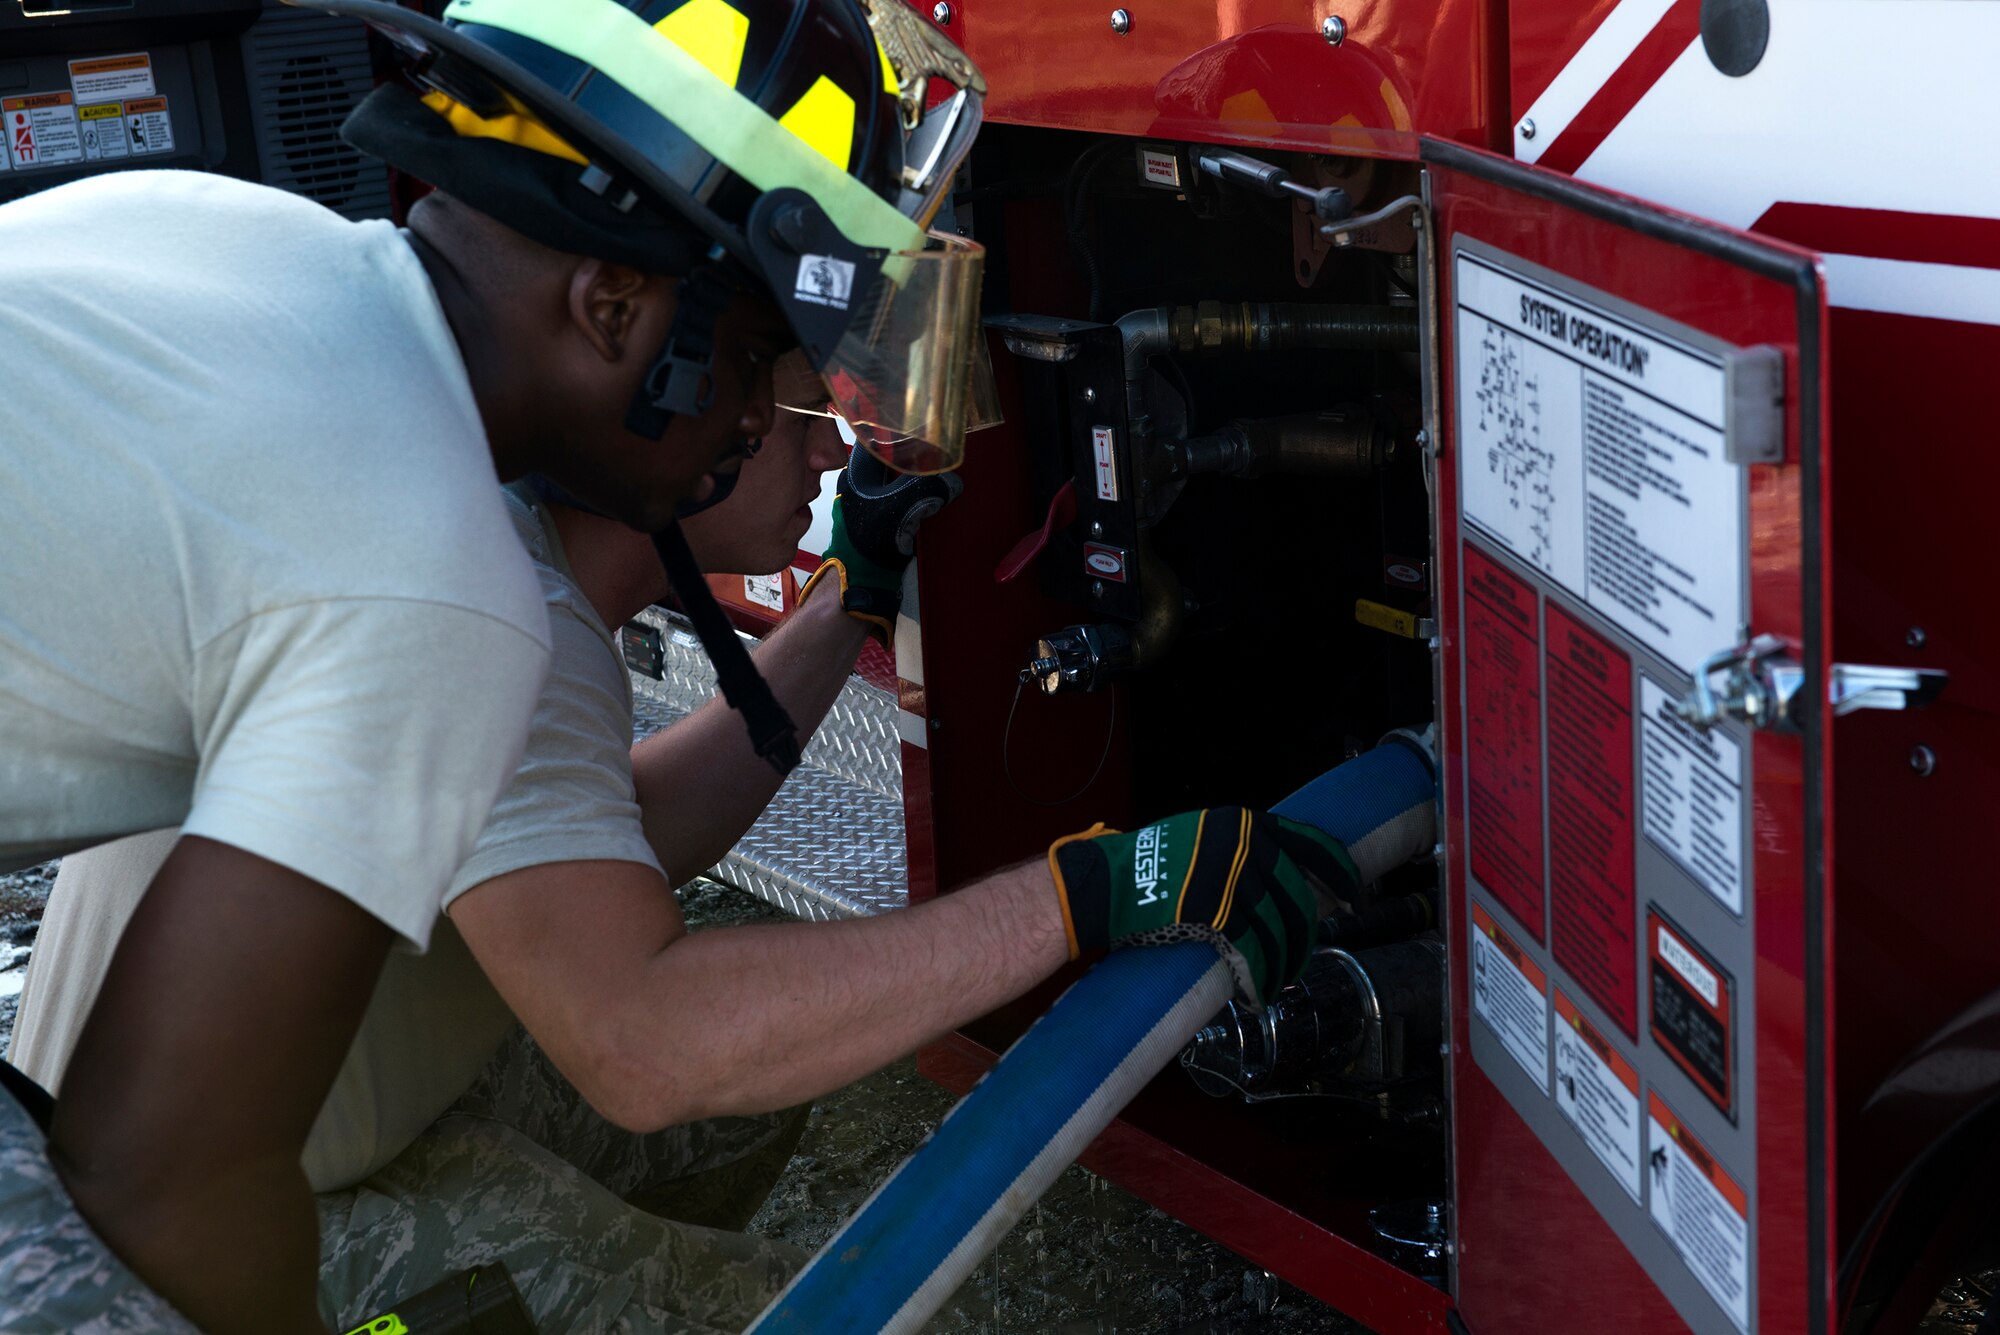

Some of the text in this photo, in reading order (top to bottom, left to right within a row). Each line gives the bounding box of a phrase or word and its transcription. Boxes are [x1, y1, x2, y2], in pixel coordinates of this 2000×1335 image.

[89, 106, 118, 117] CAUTION
[1520, 293, 1568, 343] SYSTEM
[1135, 826, 1158, 906] WESTERN
[1662, 937, 1715, 997] WATEROUS
